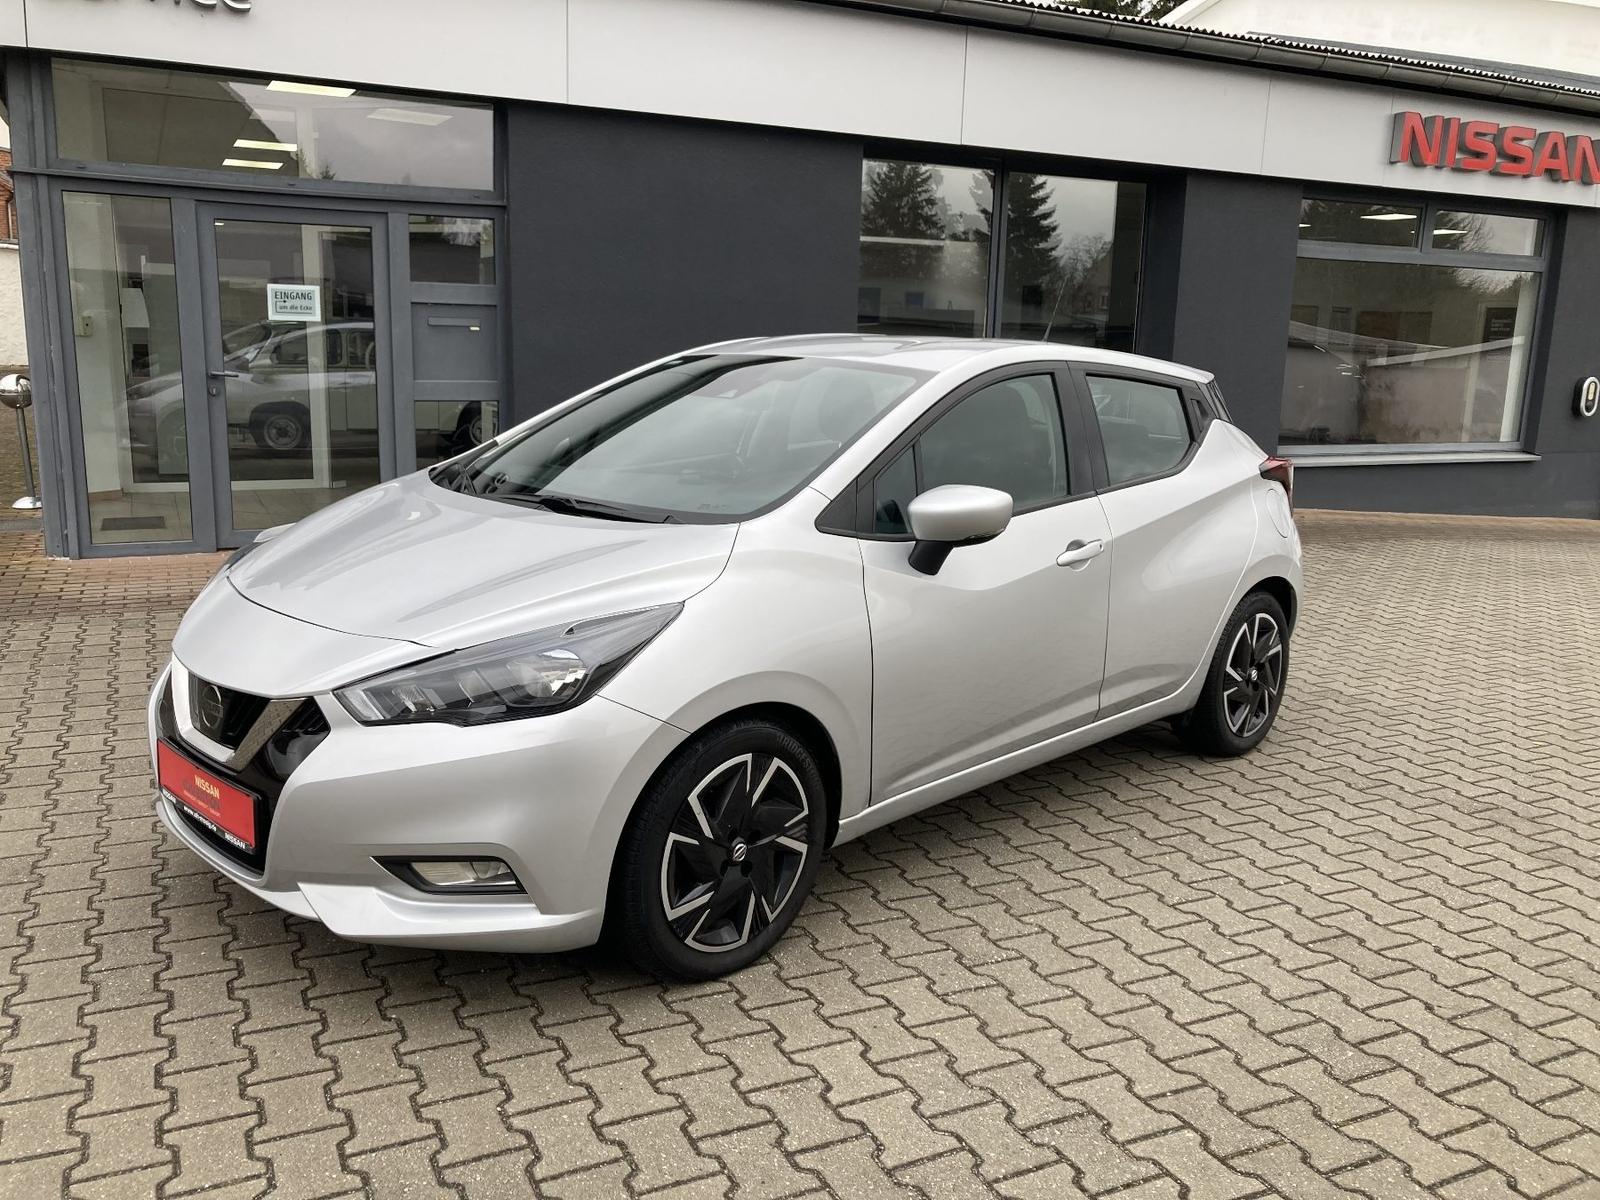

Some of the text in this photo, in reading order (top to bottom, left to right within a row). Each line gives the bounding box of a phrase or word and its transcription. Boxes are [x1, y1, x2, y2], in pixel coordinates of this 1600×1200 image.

[1390, 111, 1600, 185] NISSAN
[274, 291, 312, 300] EINGANG
[194, 774, 220, 800] NISSAN
[224, 832, 246, 850] NISSAN
